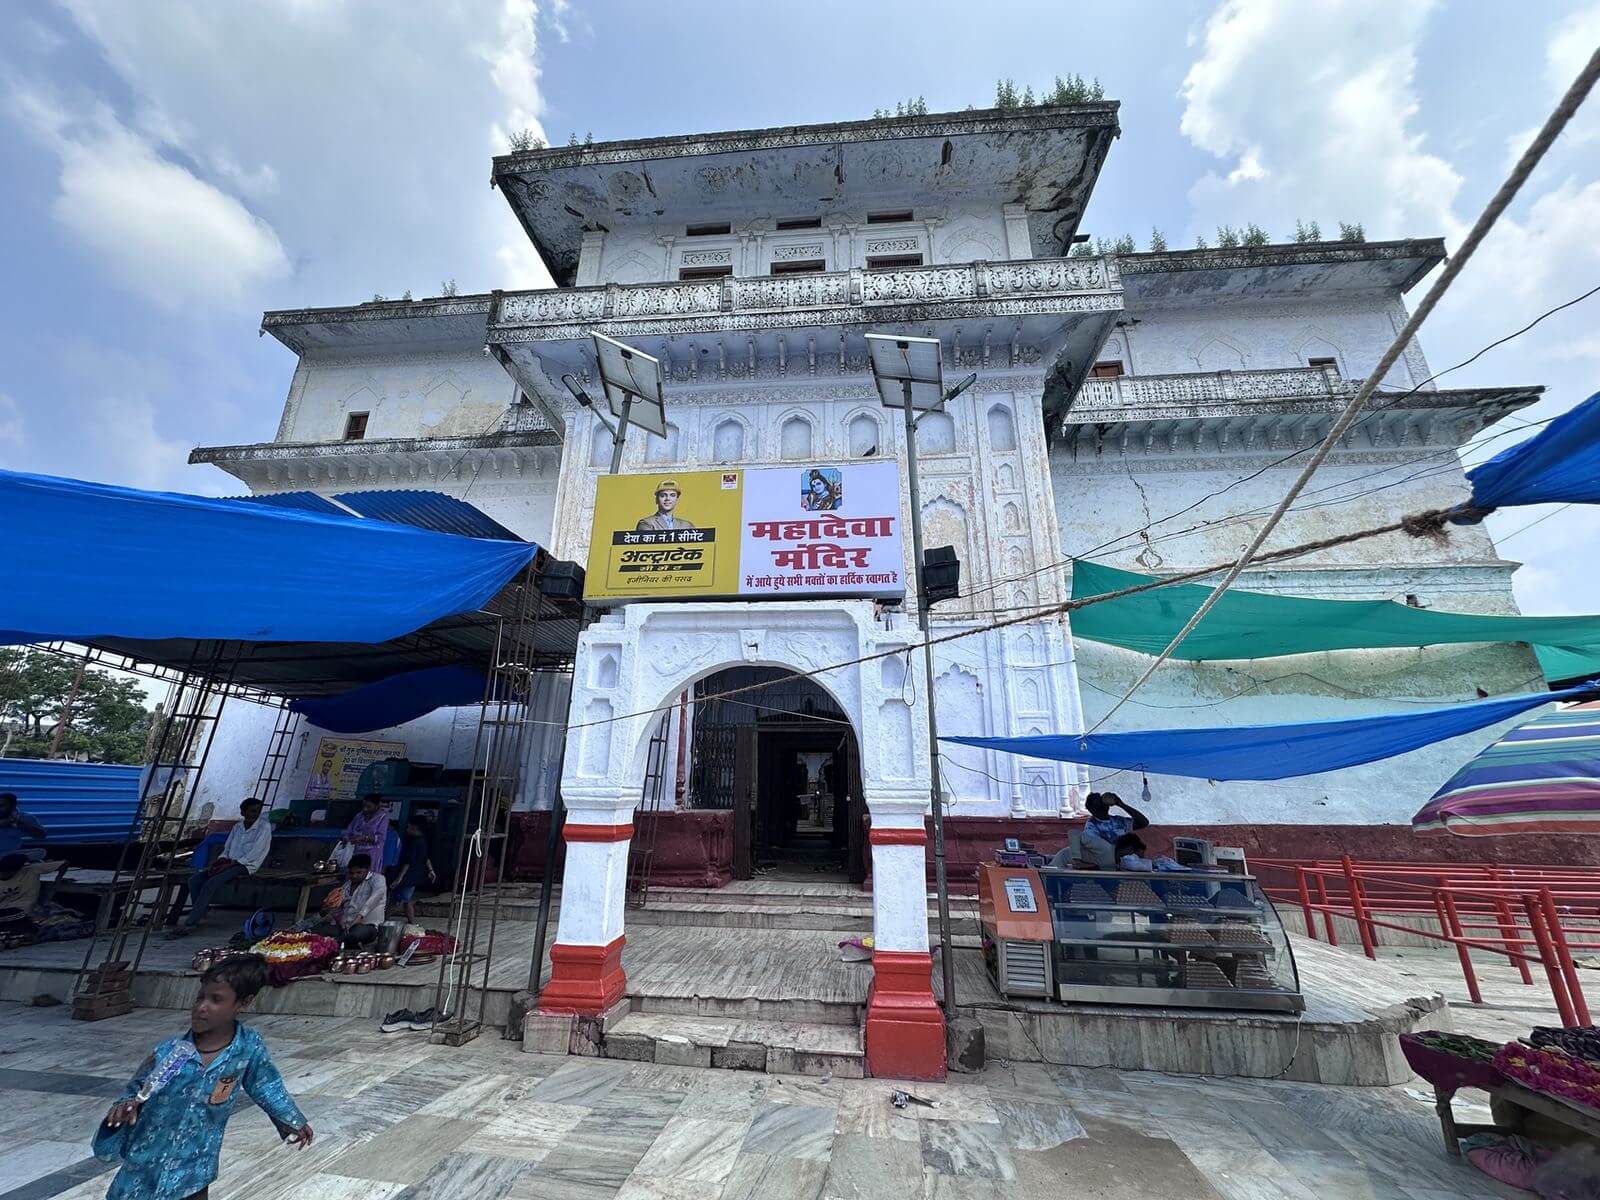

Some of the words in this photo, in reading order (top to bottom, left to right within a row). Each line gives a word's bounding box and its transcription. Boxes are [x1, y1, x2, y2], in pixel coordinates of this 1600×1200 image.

[624, 532, 640, 543] देश
[642, 534, 656, 543] का
[678, 530, 704, 542] सीमेंट
[748, 514, 895, 541] महादेवा
[771, 543, 872, 570] मंदिर
[661, 575, 672, 583] की
[746, 575, 754, 588] में
[755, 575, 772, 587] आये
[773, 575, 785, 590] हुये
[786, 574, 803, 586] सभी
[826, 574, 838, 585] का
[840, 572, 864, 585] हार्दिक
[865, 573, 890, 584] स्वागत
[890, 571, 898, 583] है
